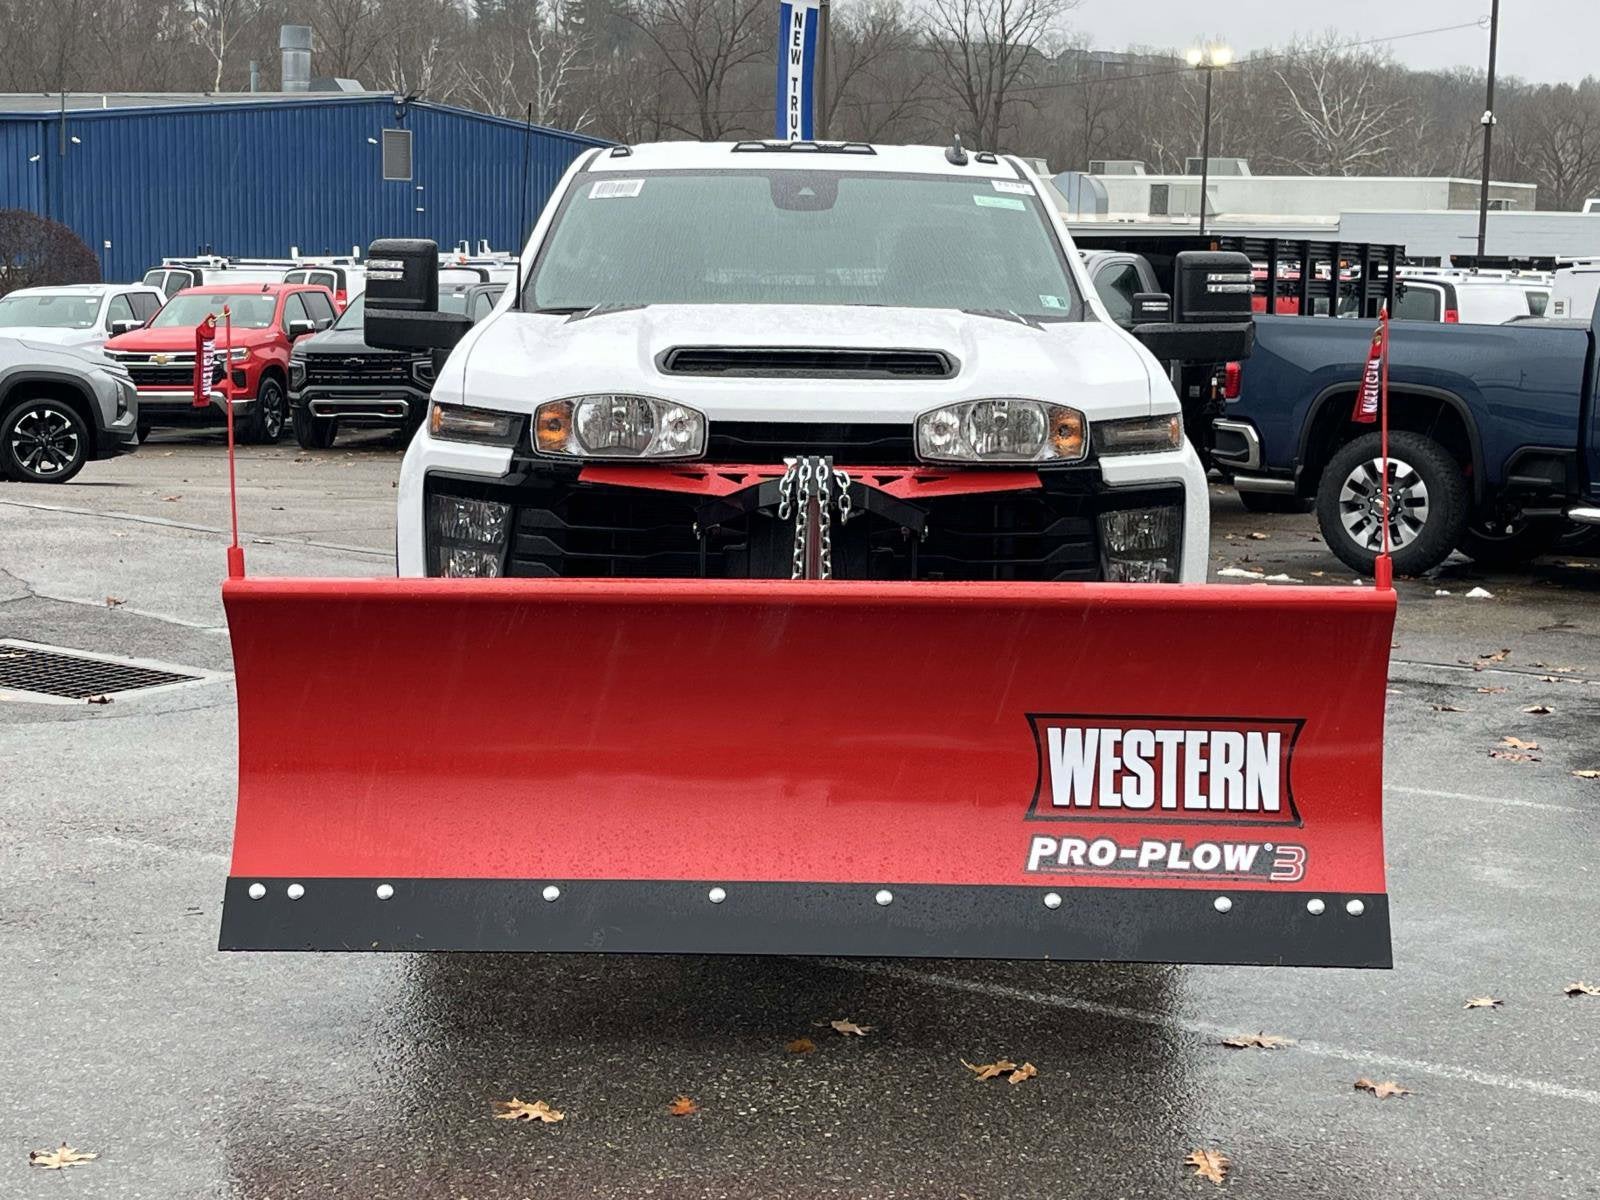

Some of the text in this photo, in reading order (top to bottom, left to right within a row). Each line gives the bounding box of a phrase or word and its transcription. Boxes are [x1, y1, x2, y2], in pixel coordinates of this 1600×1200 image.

[790, 11, 803, 65] NEW
[1046, 727, 1281, 811] WESTERN
[1270, 845, 1306, 882] 3
